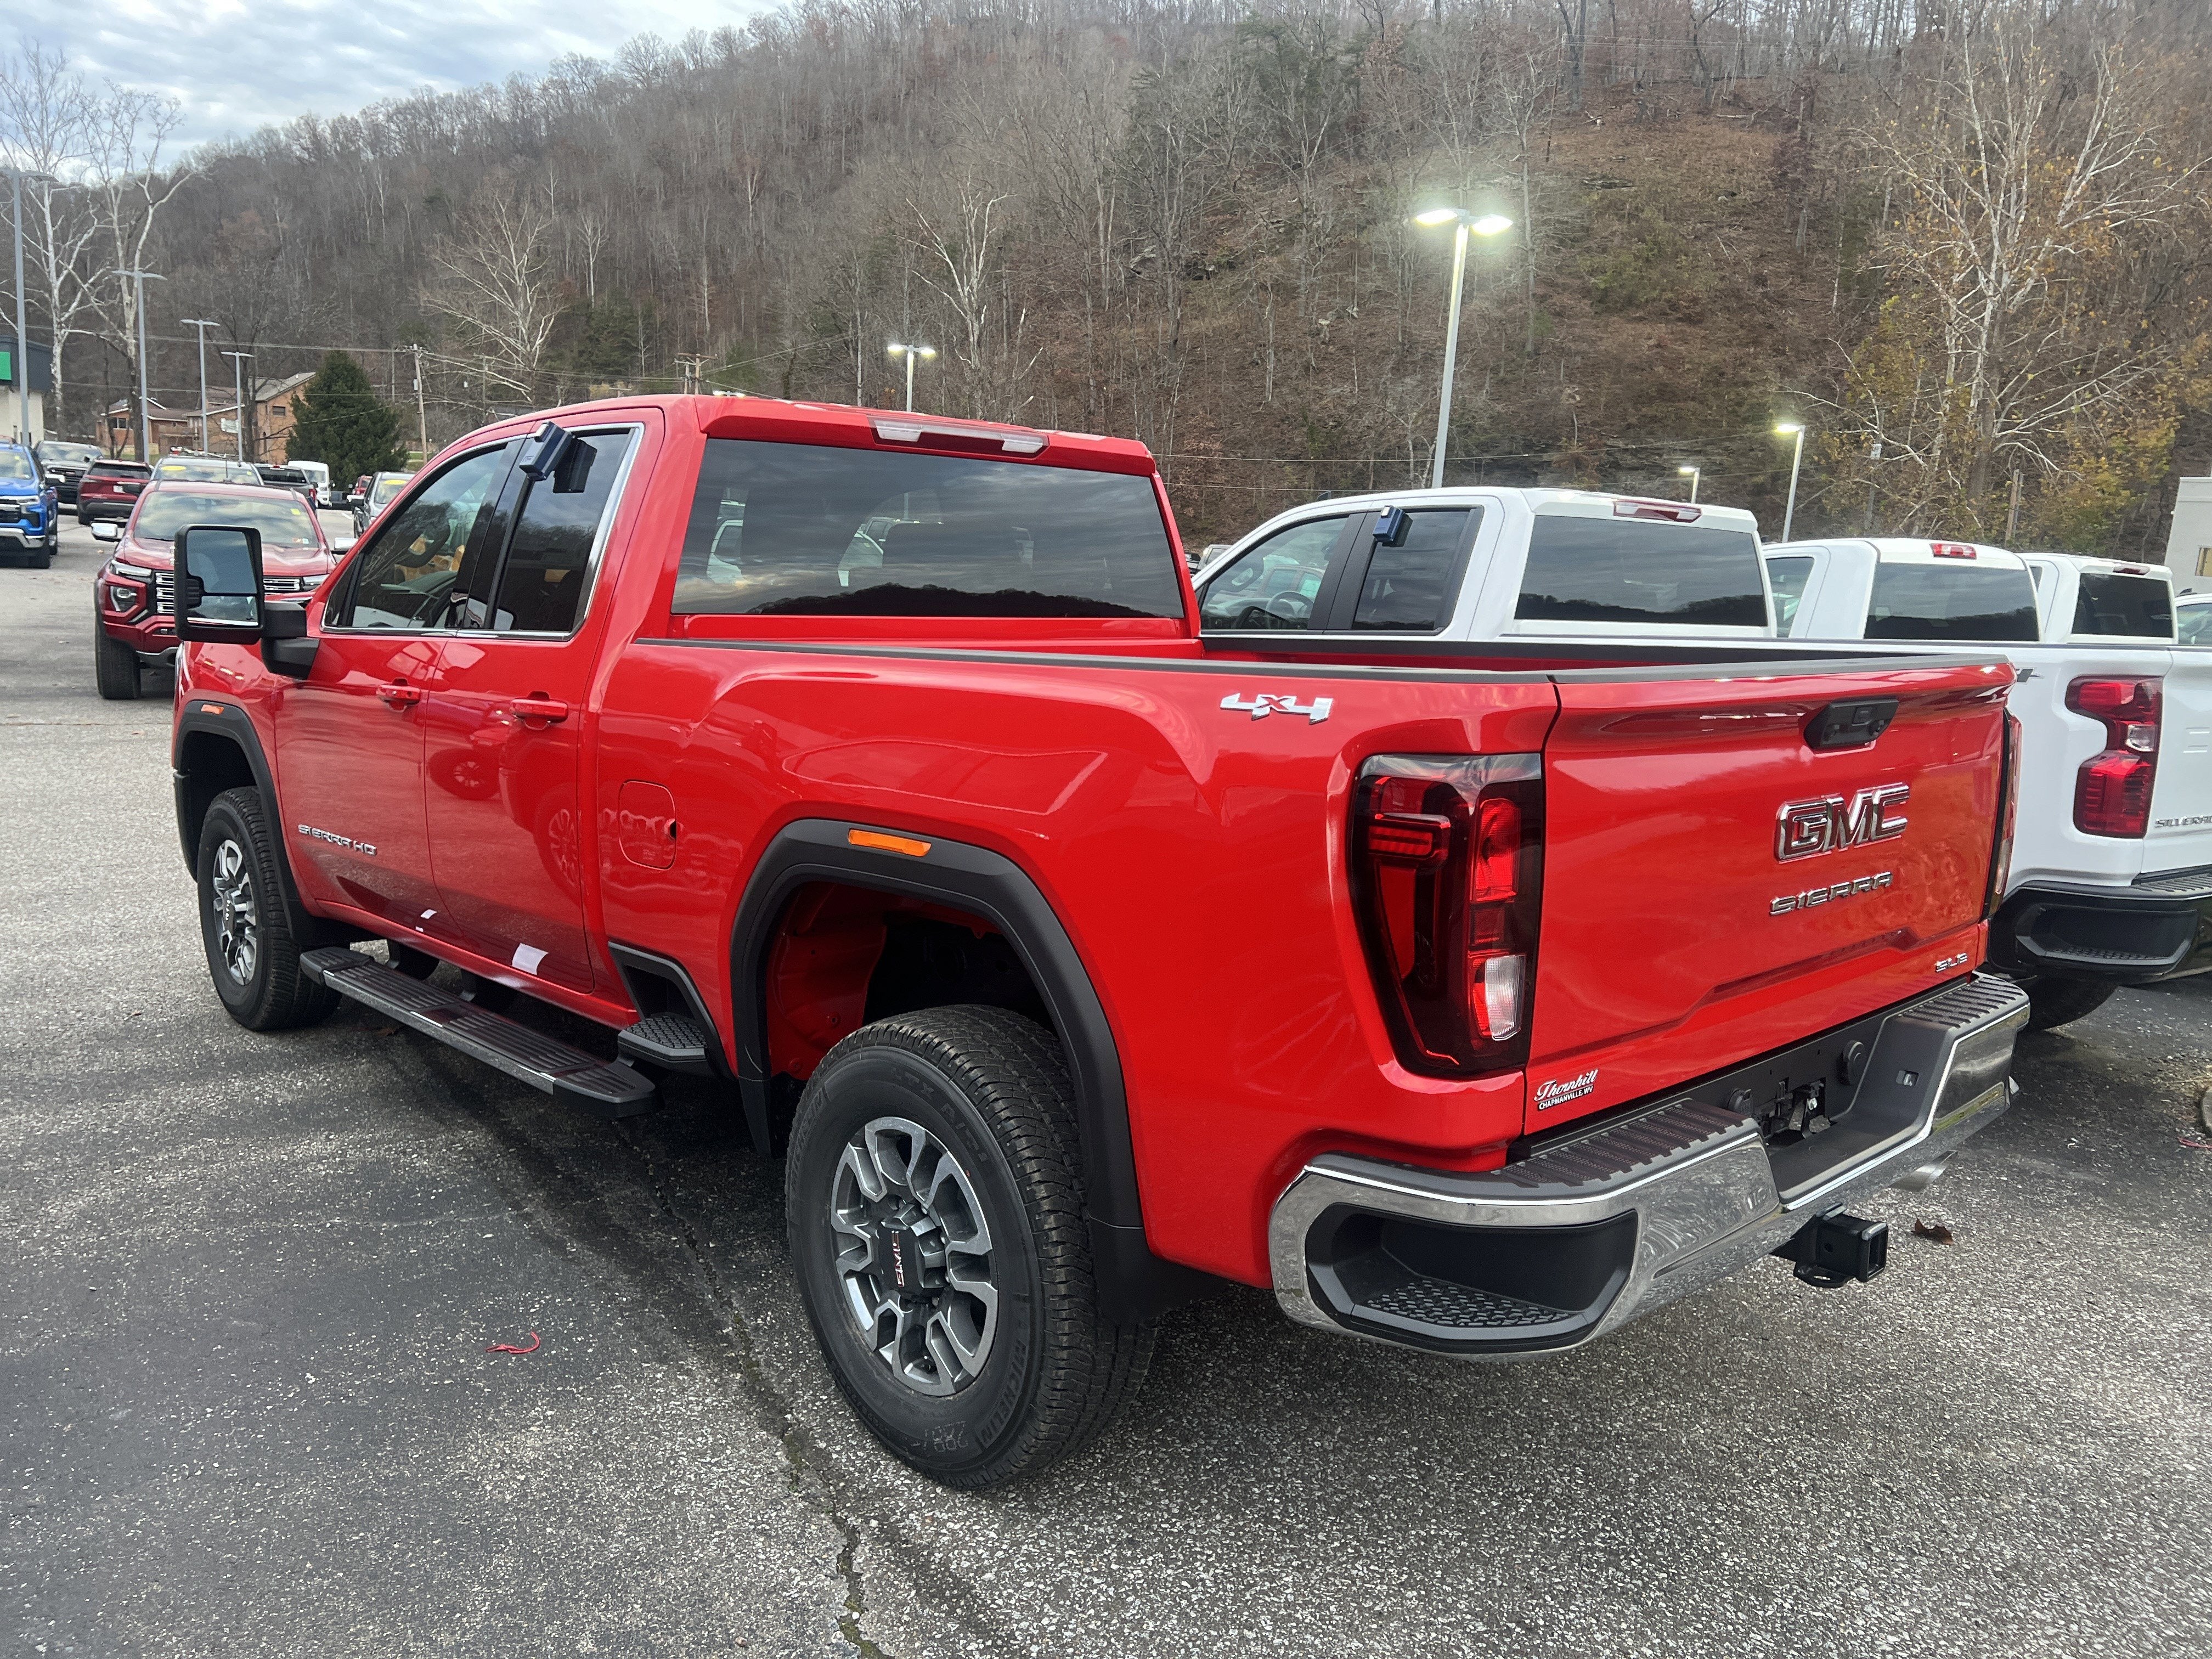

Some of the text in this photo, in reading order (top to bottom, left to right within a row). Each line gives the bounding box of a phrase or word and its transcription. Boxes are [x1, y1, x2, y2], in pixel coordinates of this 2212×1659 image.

[1774, 782, 1910, 864] GMC
[2154, 815, 2212, 828] SILVERA
[298, 823, 377, 856] SIERRA HD
[1769, 871, 1894, 917] SIERRA
[1534, 1069, 1599, 1102] Thornhill
[1583, 1086, 1593, 1095] WV
